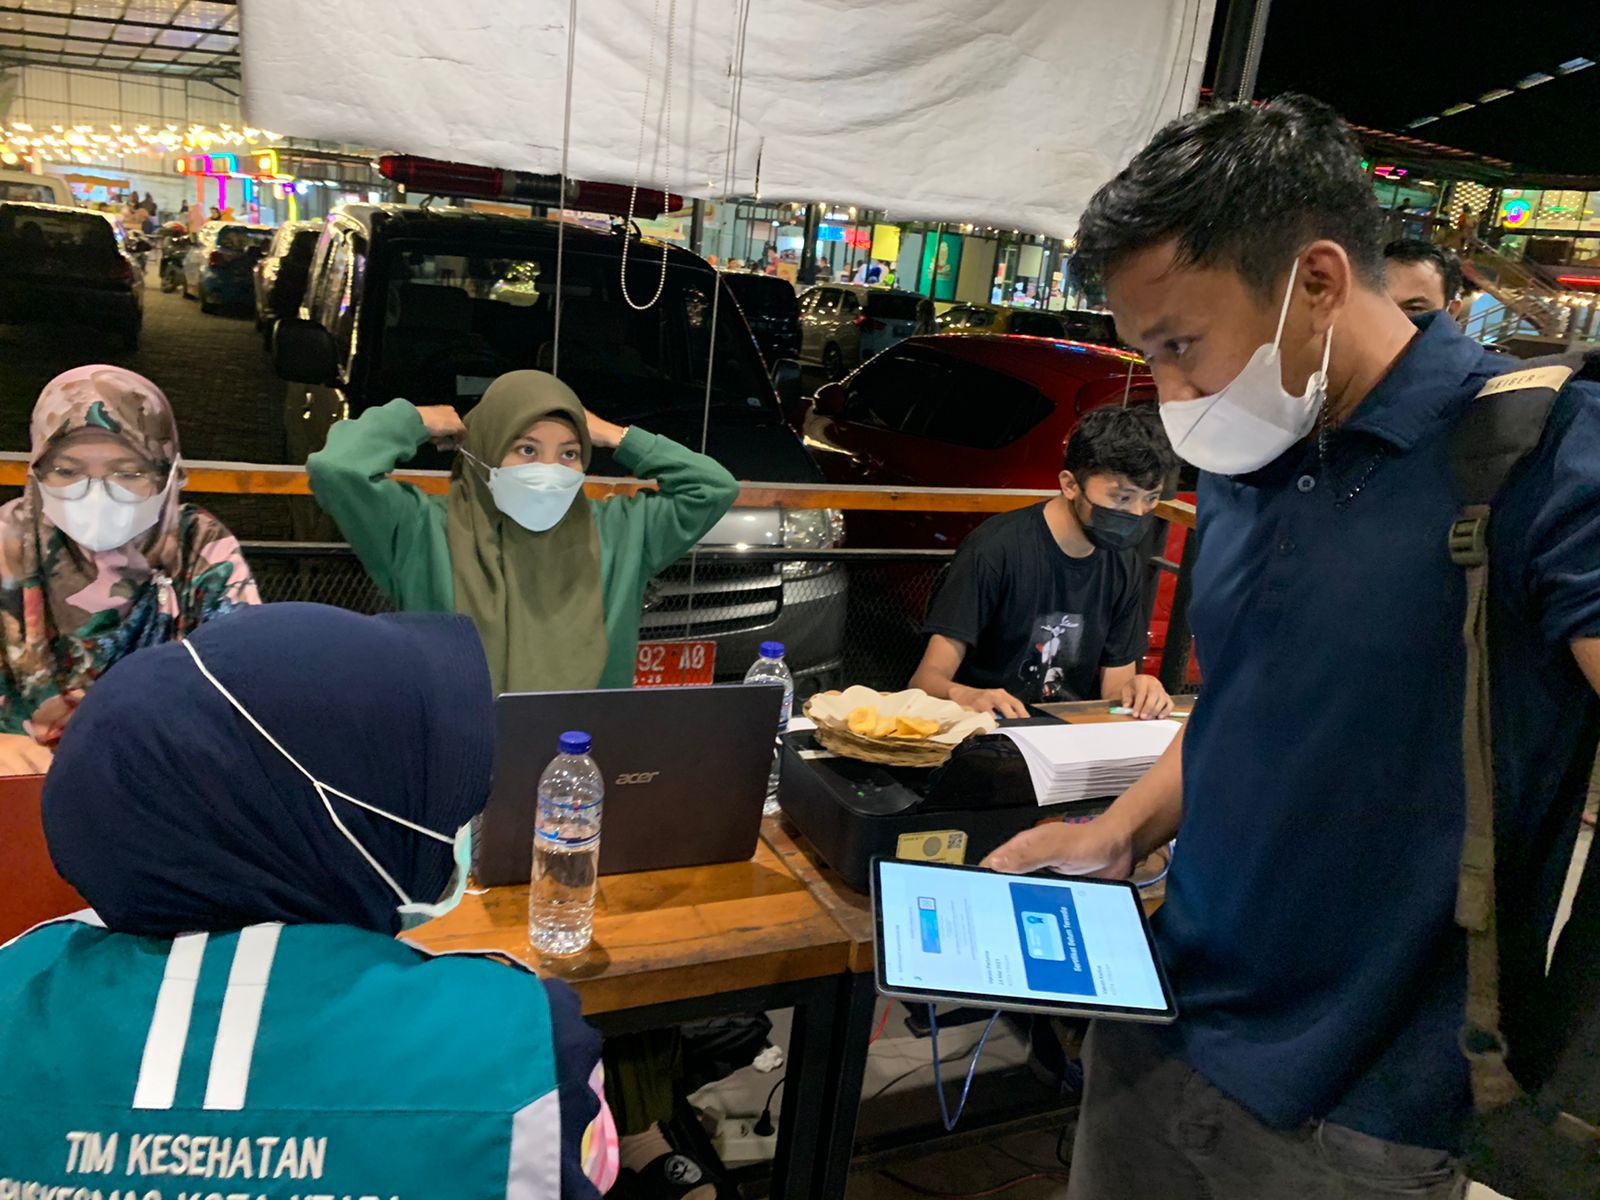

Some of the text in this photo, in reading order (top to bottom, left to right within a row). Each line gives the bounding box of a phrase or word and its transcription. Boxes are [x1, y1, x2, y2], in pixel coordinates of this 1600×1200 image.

[615, 771, 660, 785] acer
[65, 1131, 328, 1180] TIM KESEHATAN
